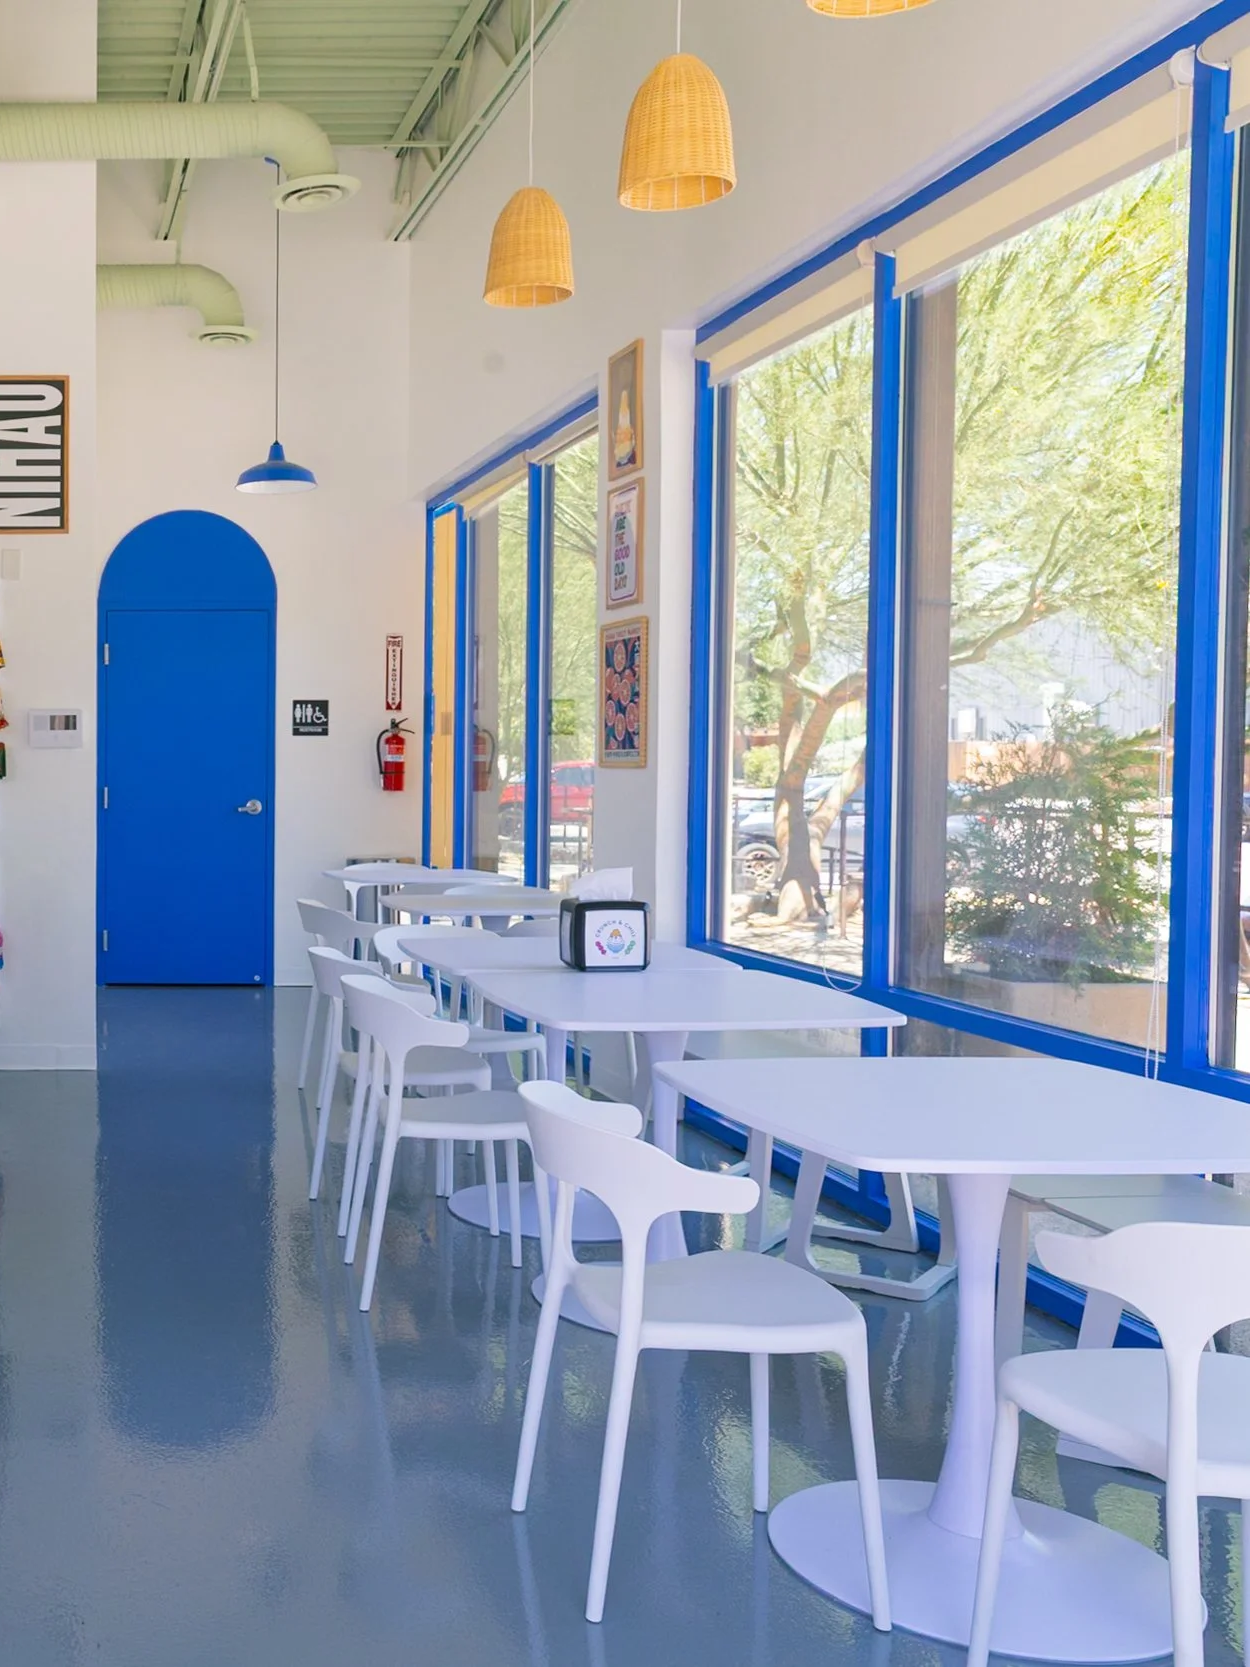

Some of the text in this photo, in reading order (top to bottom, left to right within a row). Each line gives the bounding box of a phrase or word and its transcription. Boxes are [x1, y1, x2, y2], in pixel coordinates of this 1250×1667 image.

[614, 544, 631, 562] GOOD
[613, 561, 626, 577] OLD
[387, 640, 401, 648] FIRE
[595, 920, 617, 938] CRUNCH
[623, 922, 637, 937] CHILL
